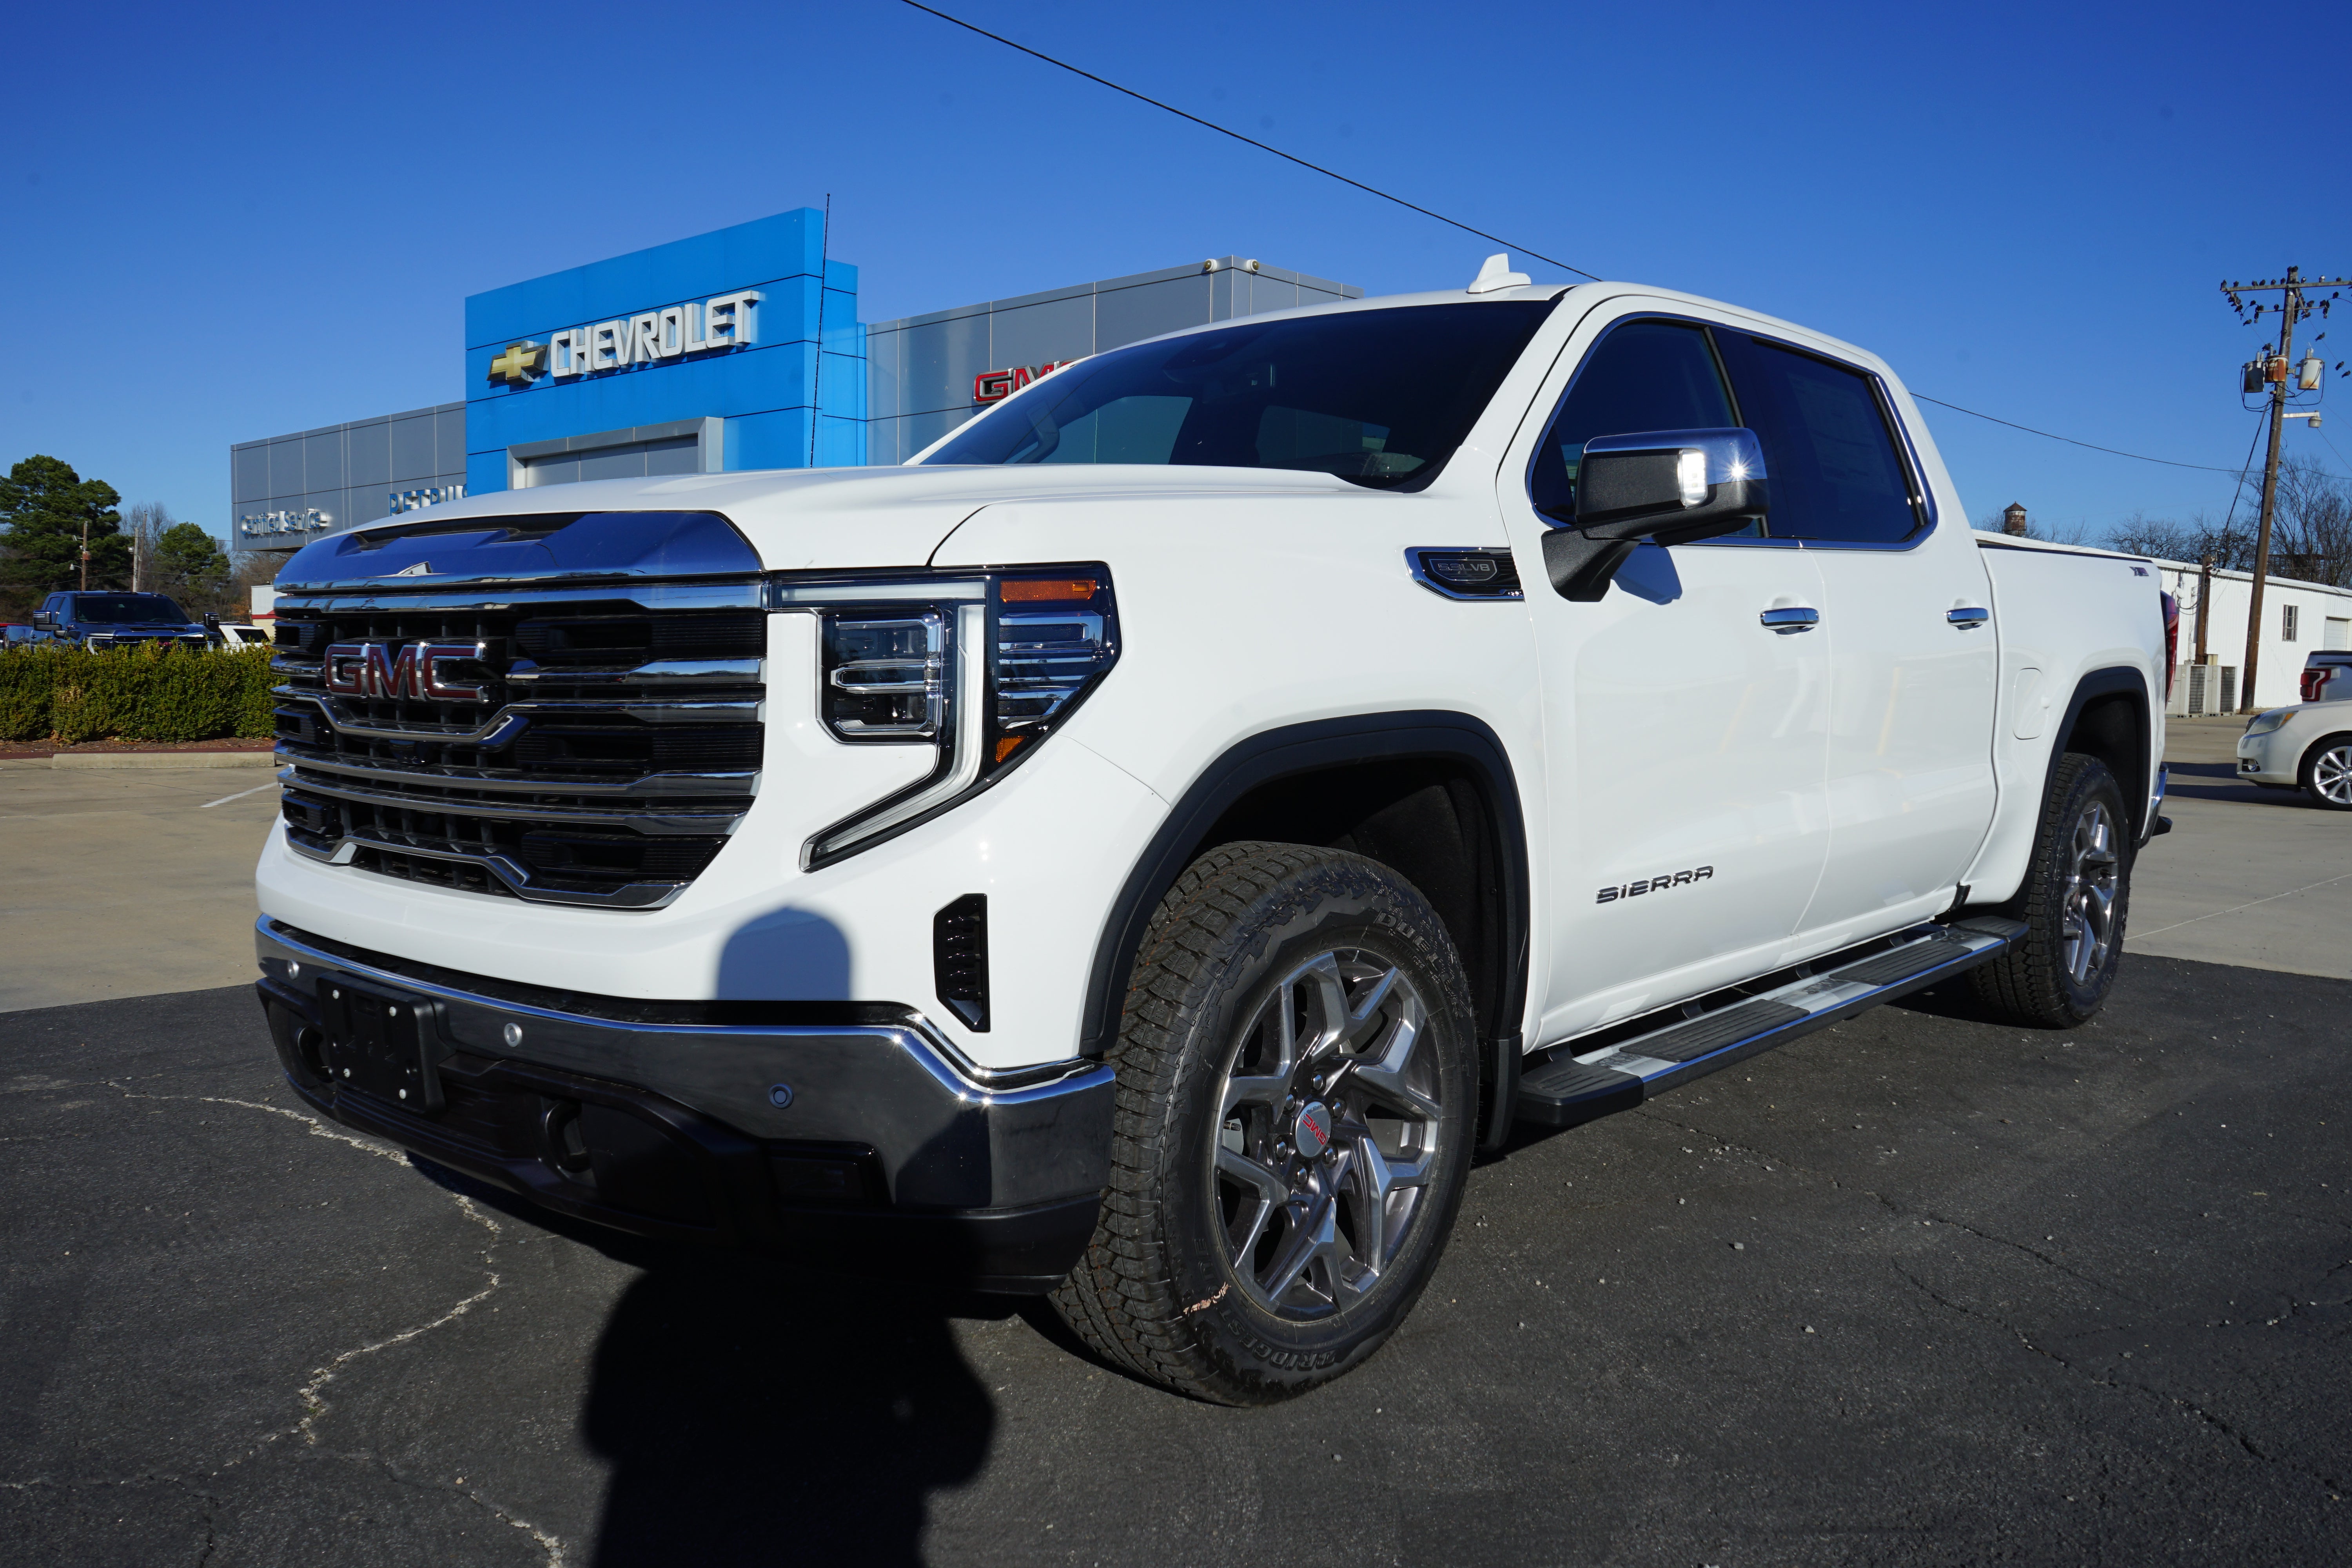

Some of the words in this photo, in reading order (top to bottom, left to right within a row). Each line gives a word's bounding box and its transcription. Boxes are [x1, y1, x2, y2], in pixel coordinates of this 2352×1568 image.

[551, 290, 760, 378] CHEVROLET
[974, 357, 1080, 405] GM
[241, 512, 280, 535] Certified
[284, 509, 328, 529] Service
[325, 642, 490, 703] GMC
[1595, 865, 1713, 904] SIERRA
[1301, 1113, 1327, 1146] GMC
[1193, 1238, 1338, 1371] BRIDGESTONE
